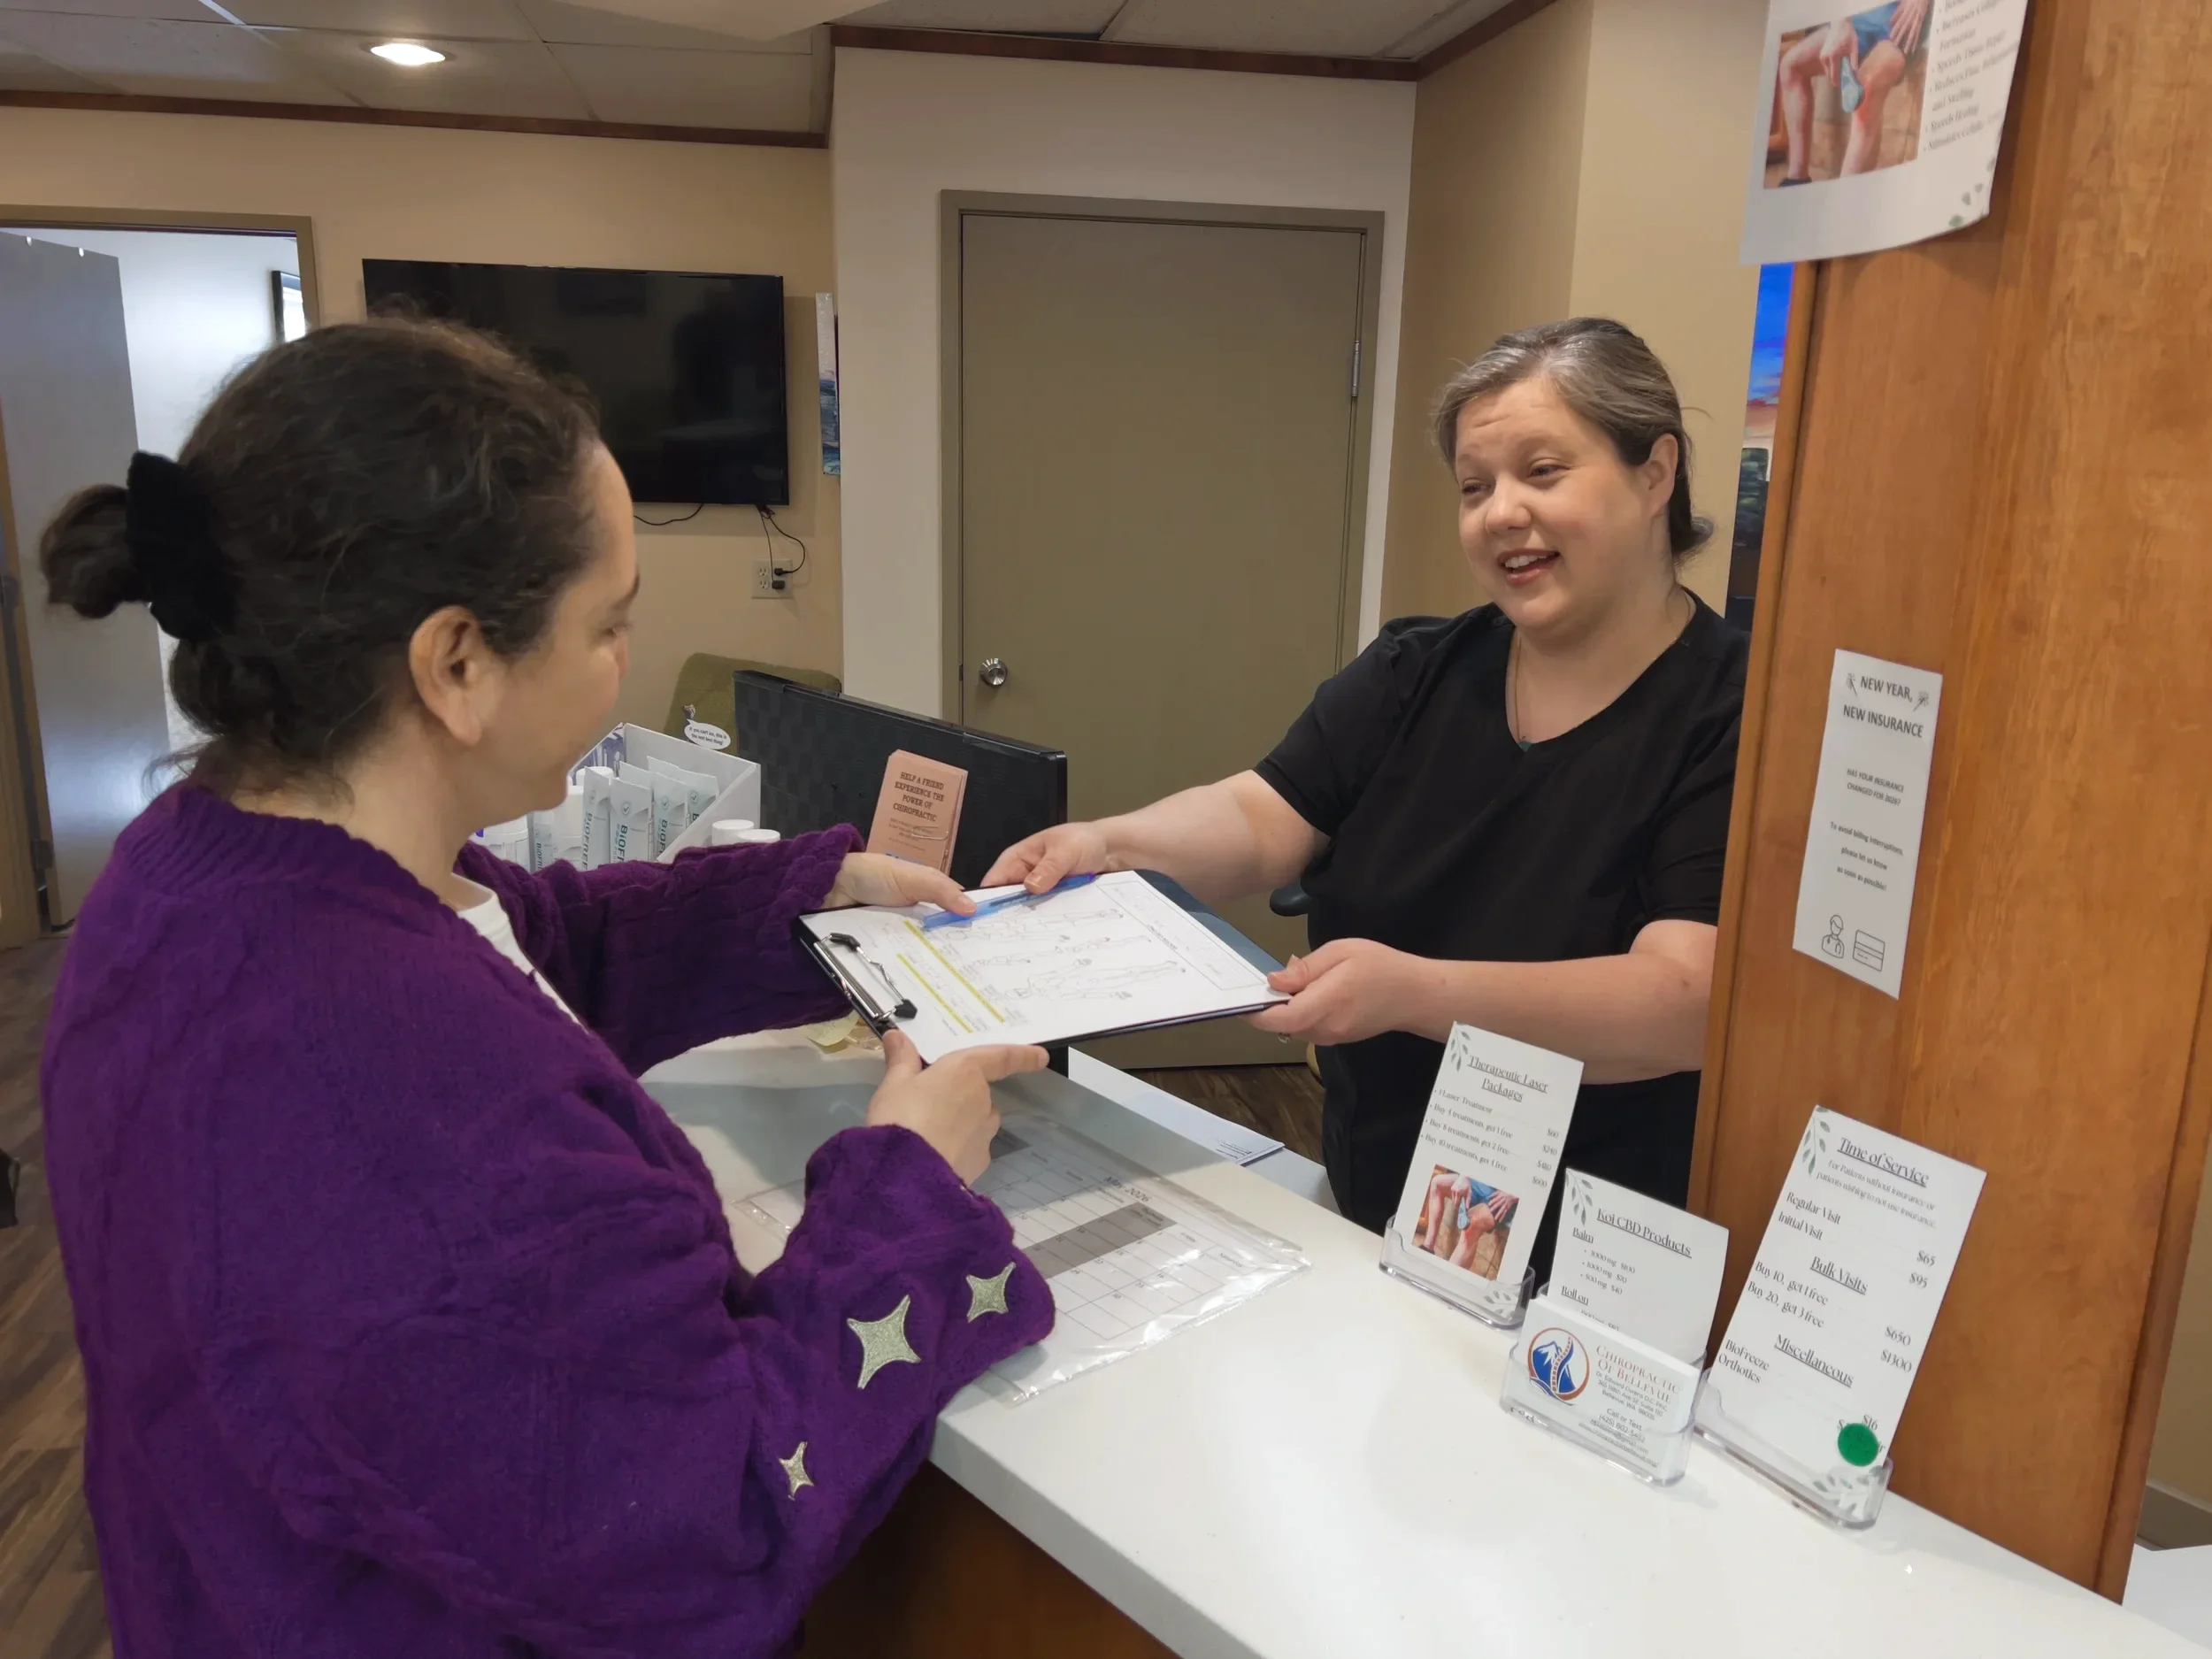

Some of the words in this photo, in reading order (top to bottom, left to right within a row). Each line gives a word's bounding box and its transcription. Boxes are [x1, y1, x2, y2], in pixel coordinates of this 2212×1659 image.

[1860, 676, 1885, 693] NEW
[1886, 681, 1913, 703] YEAR,
[1843, 704, 1866, 721] NEW
[1868, 710, 1924, 738] INSURANCE
[895, 781, 932, 798] EXPERIENCE
[933, 792, 945, 802] THE
[900, 772, 917, 782] HELP
[922, 778, 944, 790] FRIEND
[1847, 768, 1857, 777] HAS
[1859, 772, 1873, 782] YOUR
[1874, 777, 1905, 793] INSURANCE
[1847, 782, 1873, 796] CHANGED
[1873, 790, 1884, 800] FOR
[1885, 794, 1901, 806] 2026?
[893, 803, 937, 822] CHIROPRACTIC
[902, 795, 924, 808] POWER
[1831, 821, 1838, 830] To
[1838, 826, 1853, 834] avoid
[1853, 829, 1869, 842] billing
[1840, 847, 1858, 858] please
[1873, 857, 1887, 870] know
[1843, 869, 1856, 879] soon
[1468, 1055, 1521, 1083] Therapeutic
[1522, 1074, 1548, 1093] Laser
[1481, 1078, 1523, 1102] Packages
[1433, 1102, 1446, 1114] Buy
[1501, 1127, 1513, 1139] free
[1442, 1089, 1460, 1102] Laser
[1462, 1096, 1493, 1114] Treatment
[1547, 1127, 1559, 1139] $60
[1429, 1118, 1440, 1130] Buy
[1497, 1144, 1509, 1155] free
[1425, 1133, 1436, 1145] Buy
[1446, 1142, 1479, 1161] treatments,
[1495, 1161, 1508, 1171] free
[1839, 1137, 1867, 1161] Time
[1869, 1152, 1884, 1165] of
[1883, 1156, 1929, 1186] Service
[1816, 1171, 1842, 1187] patients
[1842, 1182, 1867, 1199] wishing
[1867, 1193, 1875, 1202] to
[1875, 1196, 1887, 1207] not
[1887, 1202, 1901, 1212] use
[1828, 1160, 1840, 1170] For
[1840, 1164, 1866, 1181] Patients
[1866, 1177, 1892, 1193] without
[1892, 1187, 1924, 1207] insurance
[1572, 1226, 1594, 1244] Balm
[1596, 1208, 1616, 1225] Koi
[1617, 1217, 1641, 1235] CBD
[1643, 1225, 1692, 1258] Products
[1786, 1191, 1822, 1214] Regular
[1823, 1206, 1841, 1225] Visit
[1916, 1249, 1936, 1267] $65
[1607, 1257, 1617, 1267] mg
[1778, 1210, 1804, 1232] Initial
[1804, 1221, 1824, 1240] Visit
[1909, 1271, 1928, 1288] $95
[1598, 1280, 1608, 1289] mg
[1602, 1269, 1613, 1279] mg
[1810, 1256, 1837, 1281] Bulk
[1838, 1267, 1869, 1295] Visits
[1561, 1286, 1577, 1301] Roll
[1577, 1294, 1589, 1306] on
[1755, 1261, 1770, 1279] Buy
[1773, 1270, 1785, 1285] 10,
[1787, 1280, 1803, 1293] get
[1809, 1287, 1829, 1306] free
[1884, 1325, 1911, 1347] $650
[1747, 1280, 1763, 1299] Buy
[1765, 1290, 1779, 1307] 20,
[1781, 1302, 1797, 1315] get
[1798, 1307, 1805, 1318] 3
[1804, 1310, 1824, 1328] free
[1880, 1348, 1913, 1372] $1300
[1724, 1338, 1770, 1371] BioFreeze
[1774, 1333, 1855, 1388] Miscellaneous
[1596, 1345, 1681, 1394] CHIROPRACTIC
[1718, 1353, 1763, 1384] Orthotics
[1604, 1374, 1624, 1389] Edward
[1624, 1386, 1643, 1399] Owens
[1617, 1369, 1671, 1404] BELLEVUE
[1622, 1392, 1632, 1401] Ave
[1640, 1401, 1654, 1412] Suite
[1626, 1402, 1636, 1410] WA
[1599, 1413, 1615, 1427] (425)
[1607, 1408, 1620, 1418] Call
[1629, 1418, 1642, 1432] Text
